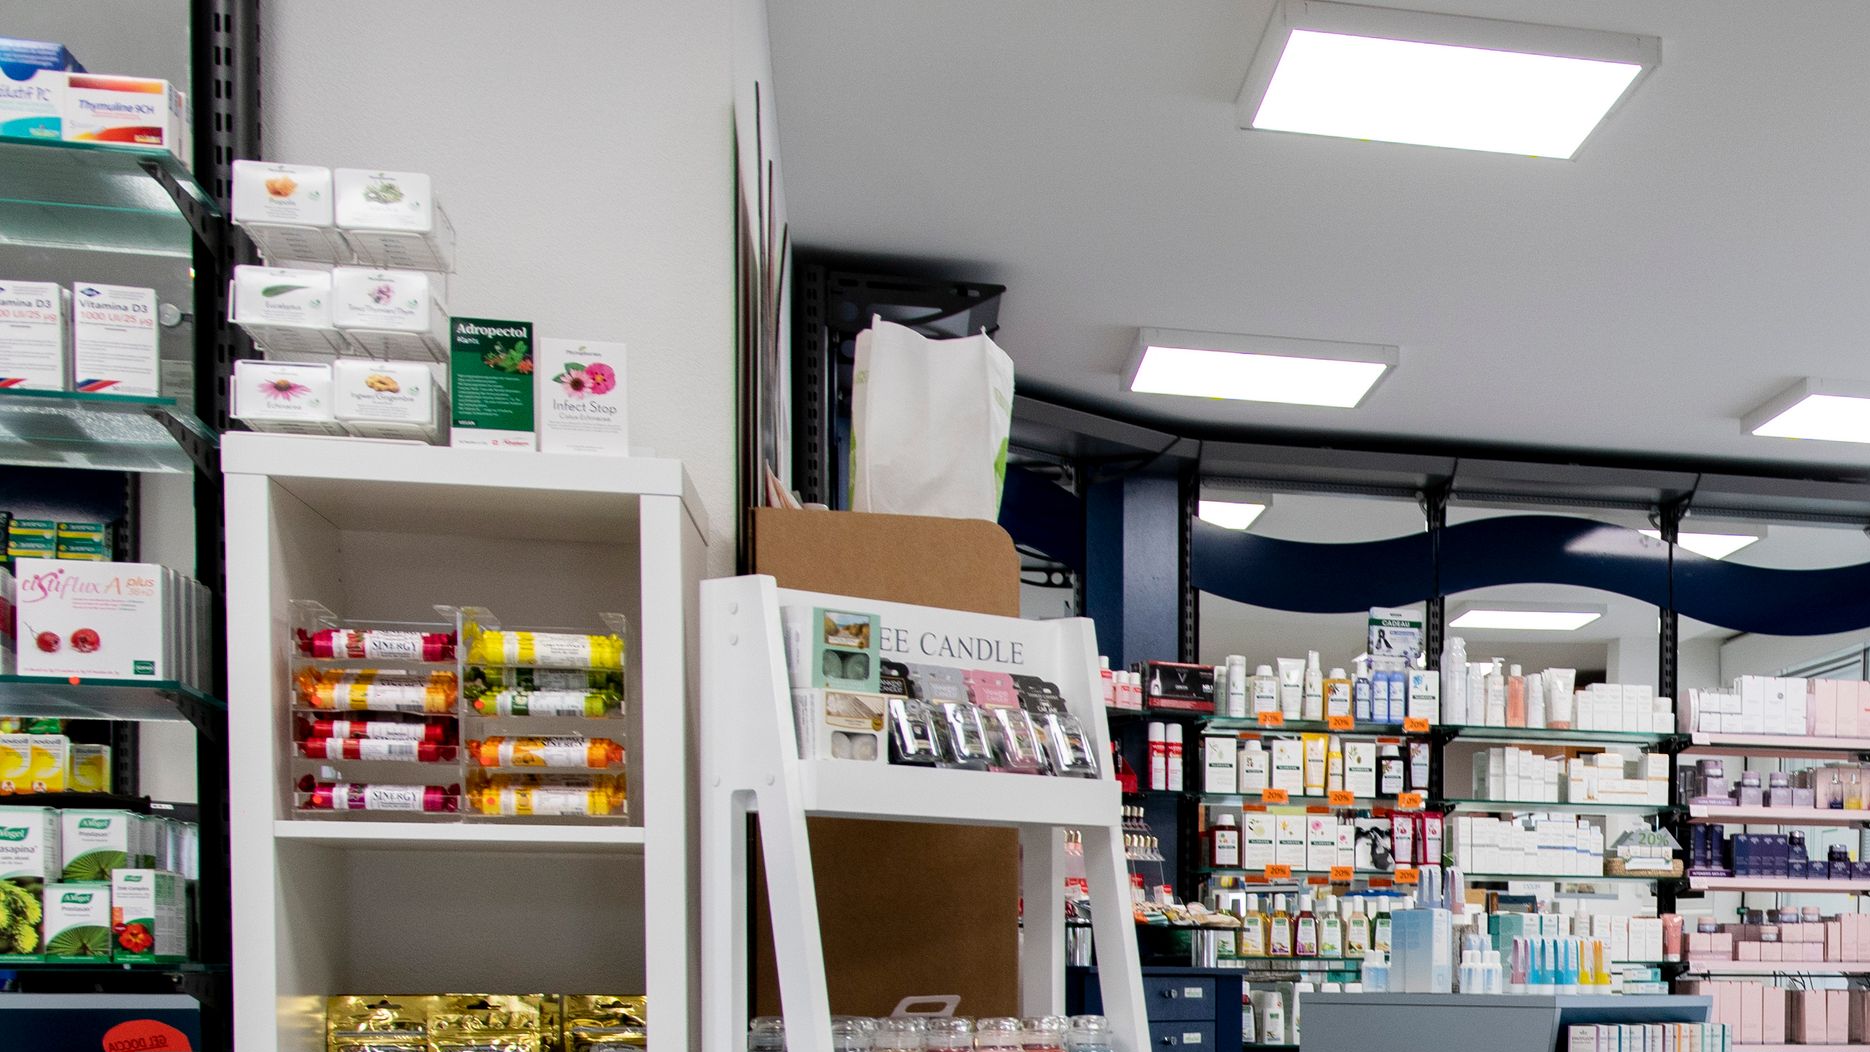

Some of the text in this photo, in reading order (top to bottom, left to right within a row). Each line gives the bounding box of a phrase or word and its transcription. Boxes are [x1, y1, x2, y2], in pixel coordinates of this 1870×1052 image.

[80, 300, 148, 314] Vitamina D3
[456, 323, 528, 339] Adropectol
[553, 399, 617, 415] Infect Stop
[1382, 619, 1411, 627] CADEAU
[920, 631, 1024, 665] CANDLE
[1263, 714, 1279, 723] 20%
[1333, 717, 1349, 727] 20%
[1267, 791, 1283, 801] 20%
[1333, 793, 1348, 802] 20%
[1270, 867, 1286, 876] 20%
[1335, 869, 1351, 878] 20%
[1400, 871, 1415, 880] 20%
